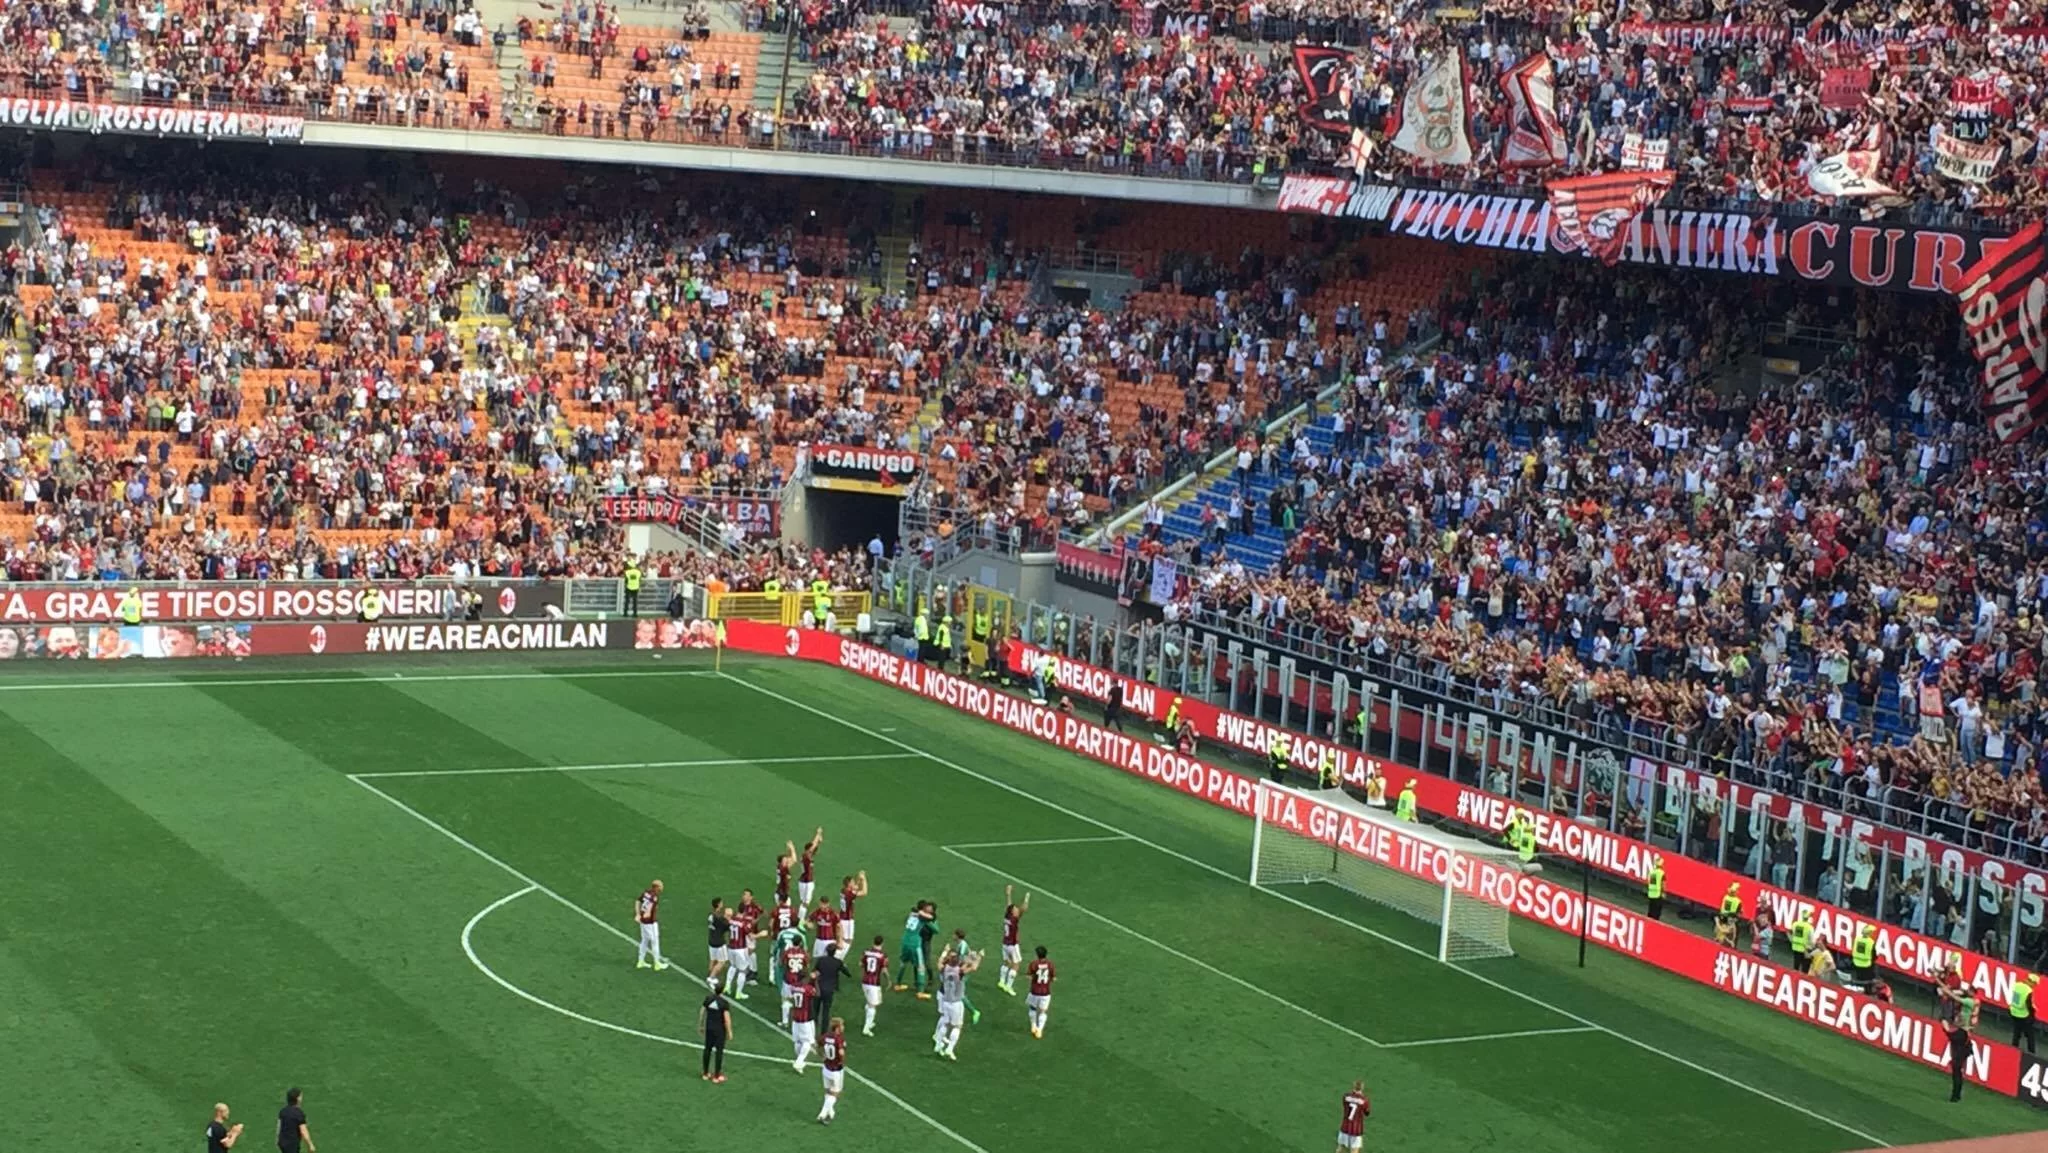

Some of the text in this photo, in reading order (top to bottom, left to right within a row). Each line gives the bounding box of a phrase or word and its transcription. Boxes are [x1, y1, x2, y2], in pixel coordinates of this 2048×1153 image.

[98, 104, 239, 136] ROSSONERA
[1388, 188, 1551, 252] VECCHIA
[1600, 208, 1779, 275] ANIERA
[1958, 273, 2034, 442] BARESI
[828, 449, 916, 473] CARUSO
[45, 590, 160, 618] GRAZE
[167, 590, 265, 618] TIFOSI
[365, 622, 608, 652] #WEAREACMILAN
[839, 639, 1645, 955] SEMPRE AL NOSTRO FIANCO, PARTITA DOPO PARTITA. GRAZIE TIFOSI ROSSONERI!
[1036, 969, 1049, 984] 14
[1348, 1103, 1358, 1121] 7
